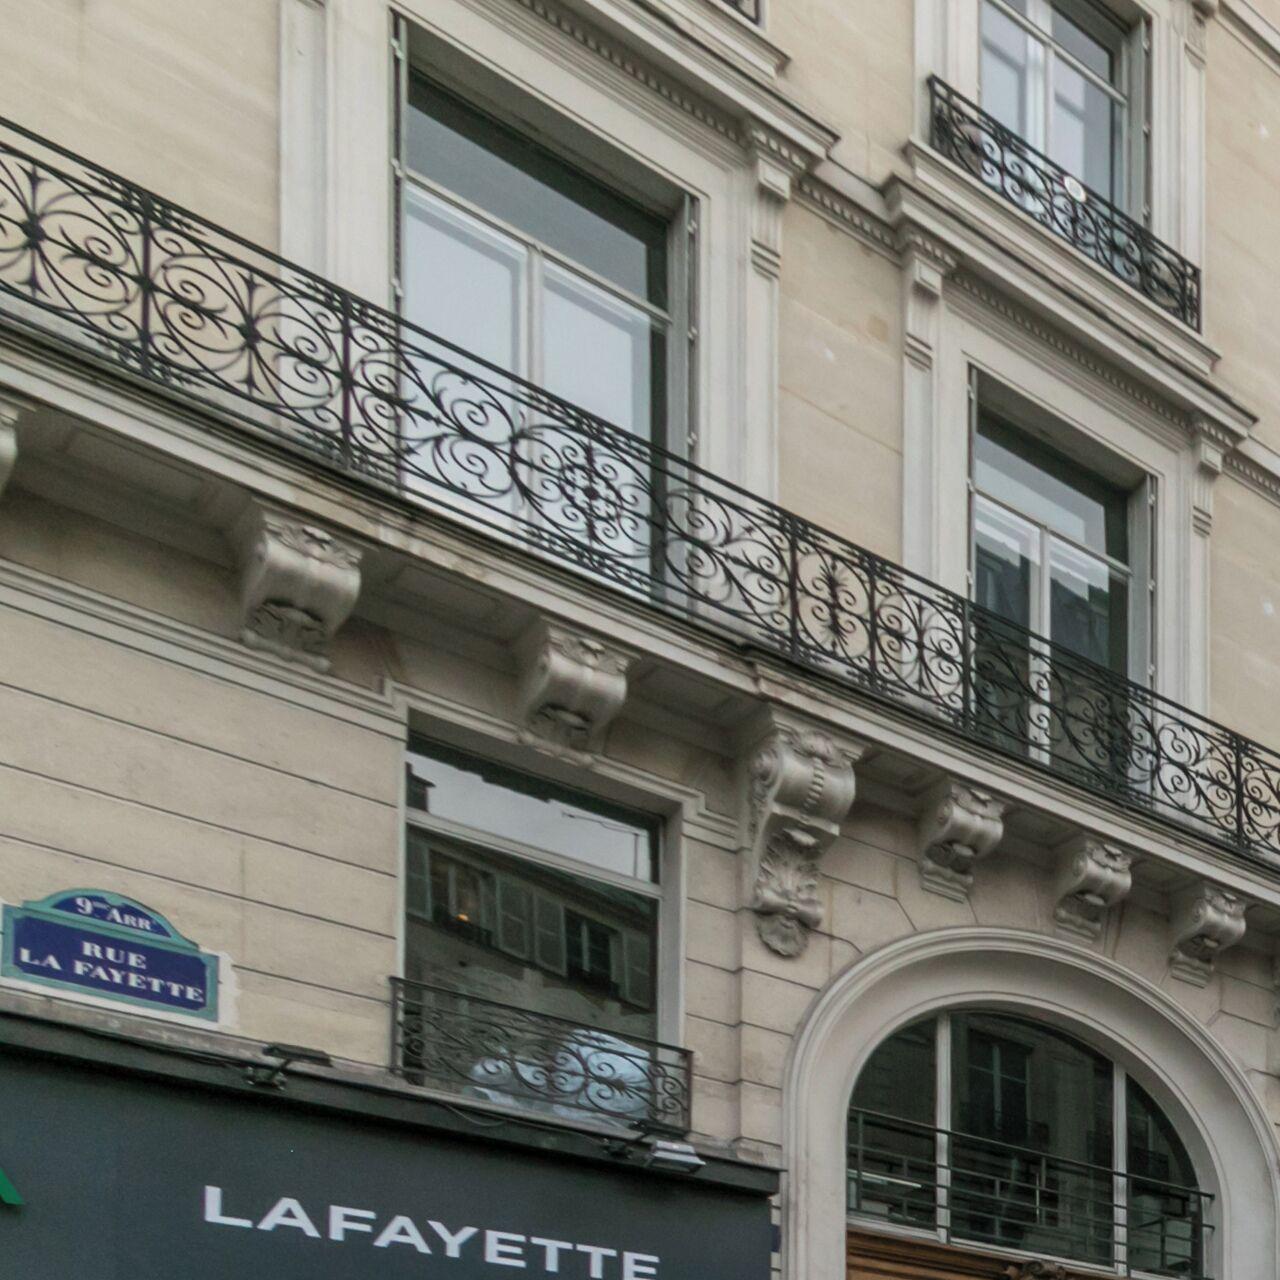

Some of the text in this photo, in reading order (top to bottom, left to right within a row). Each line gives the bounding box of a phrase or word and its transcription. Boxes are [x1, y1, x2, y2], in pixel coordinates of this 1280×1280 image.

[20, 947, 204, 1002] LA FAYETTE
[82, 941, 146, 969] RUE
